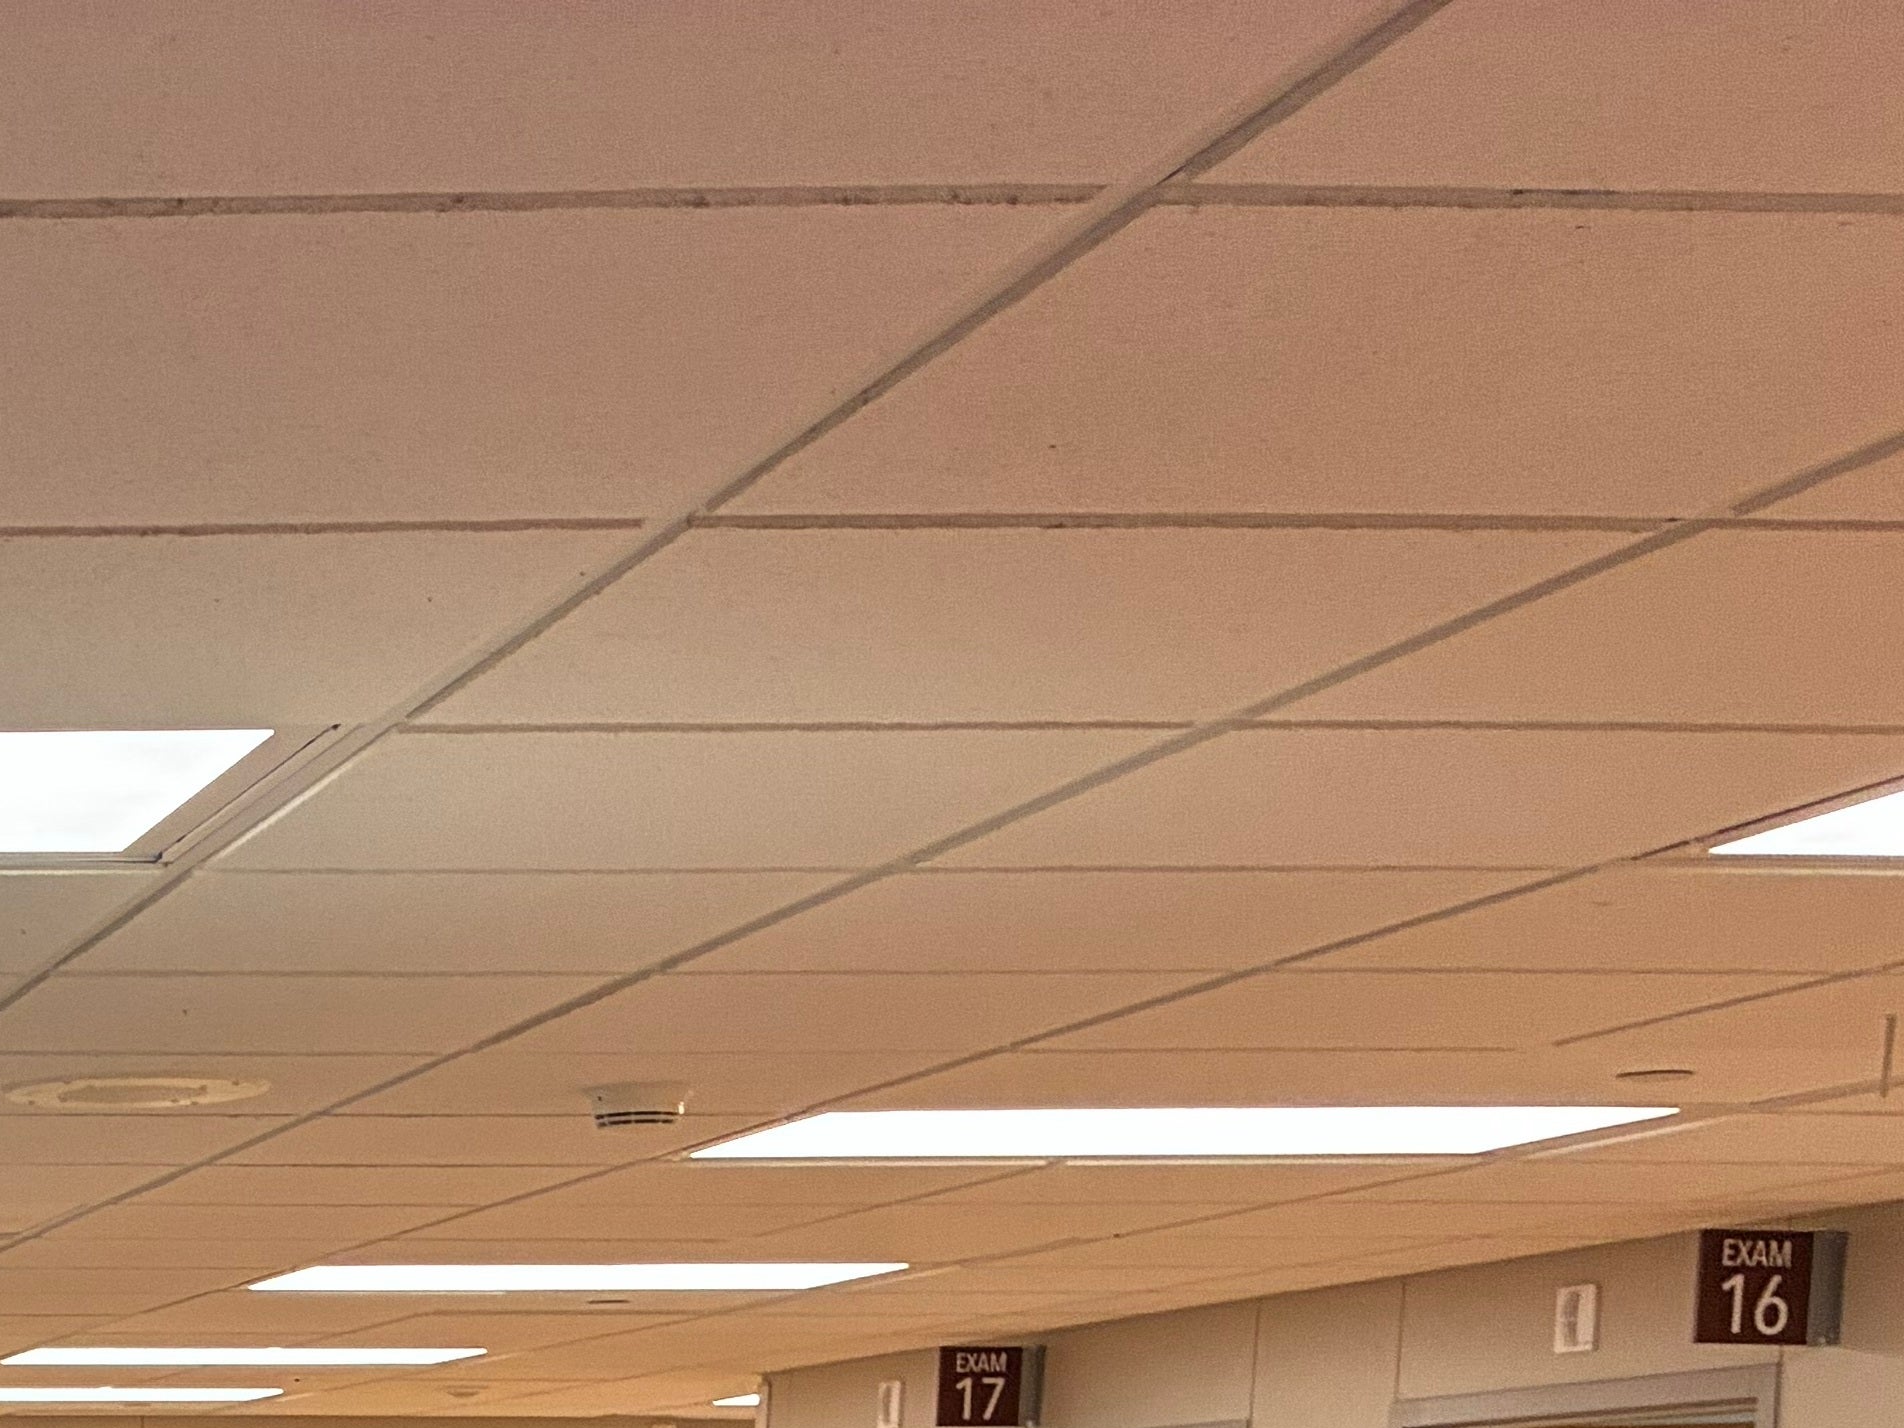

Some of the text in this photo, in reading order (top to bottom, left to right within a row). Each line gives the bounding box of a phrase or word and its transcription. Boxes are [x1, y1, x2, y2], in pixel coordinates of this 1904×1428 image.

[1721, 1237, 1793, 1269] EXAM
[1721, 1273, 1790, 1336] 16
[955, 1350, 1009, 1374] EXAM
[955, 1376, 1006, 1422] 17
